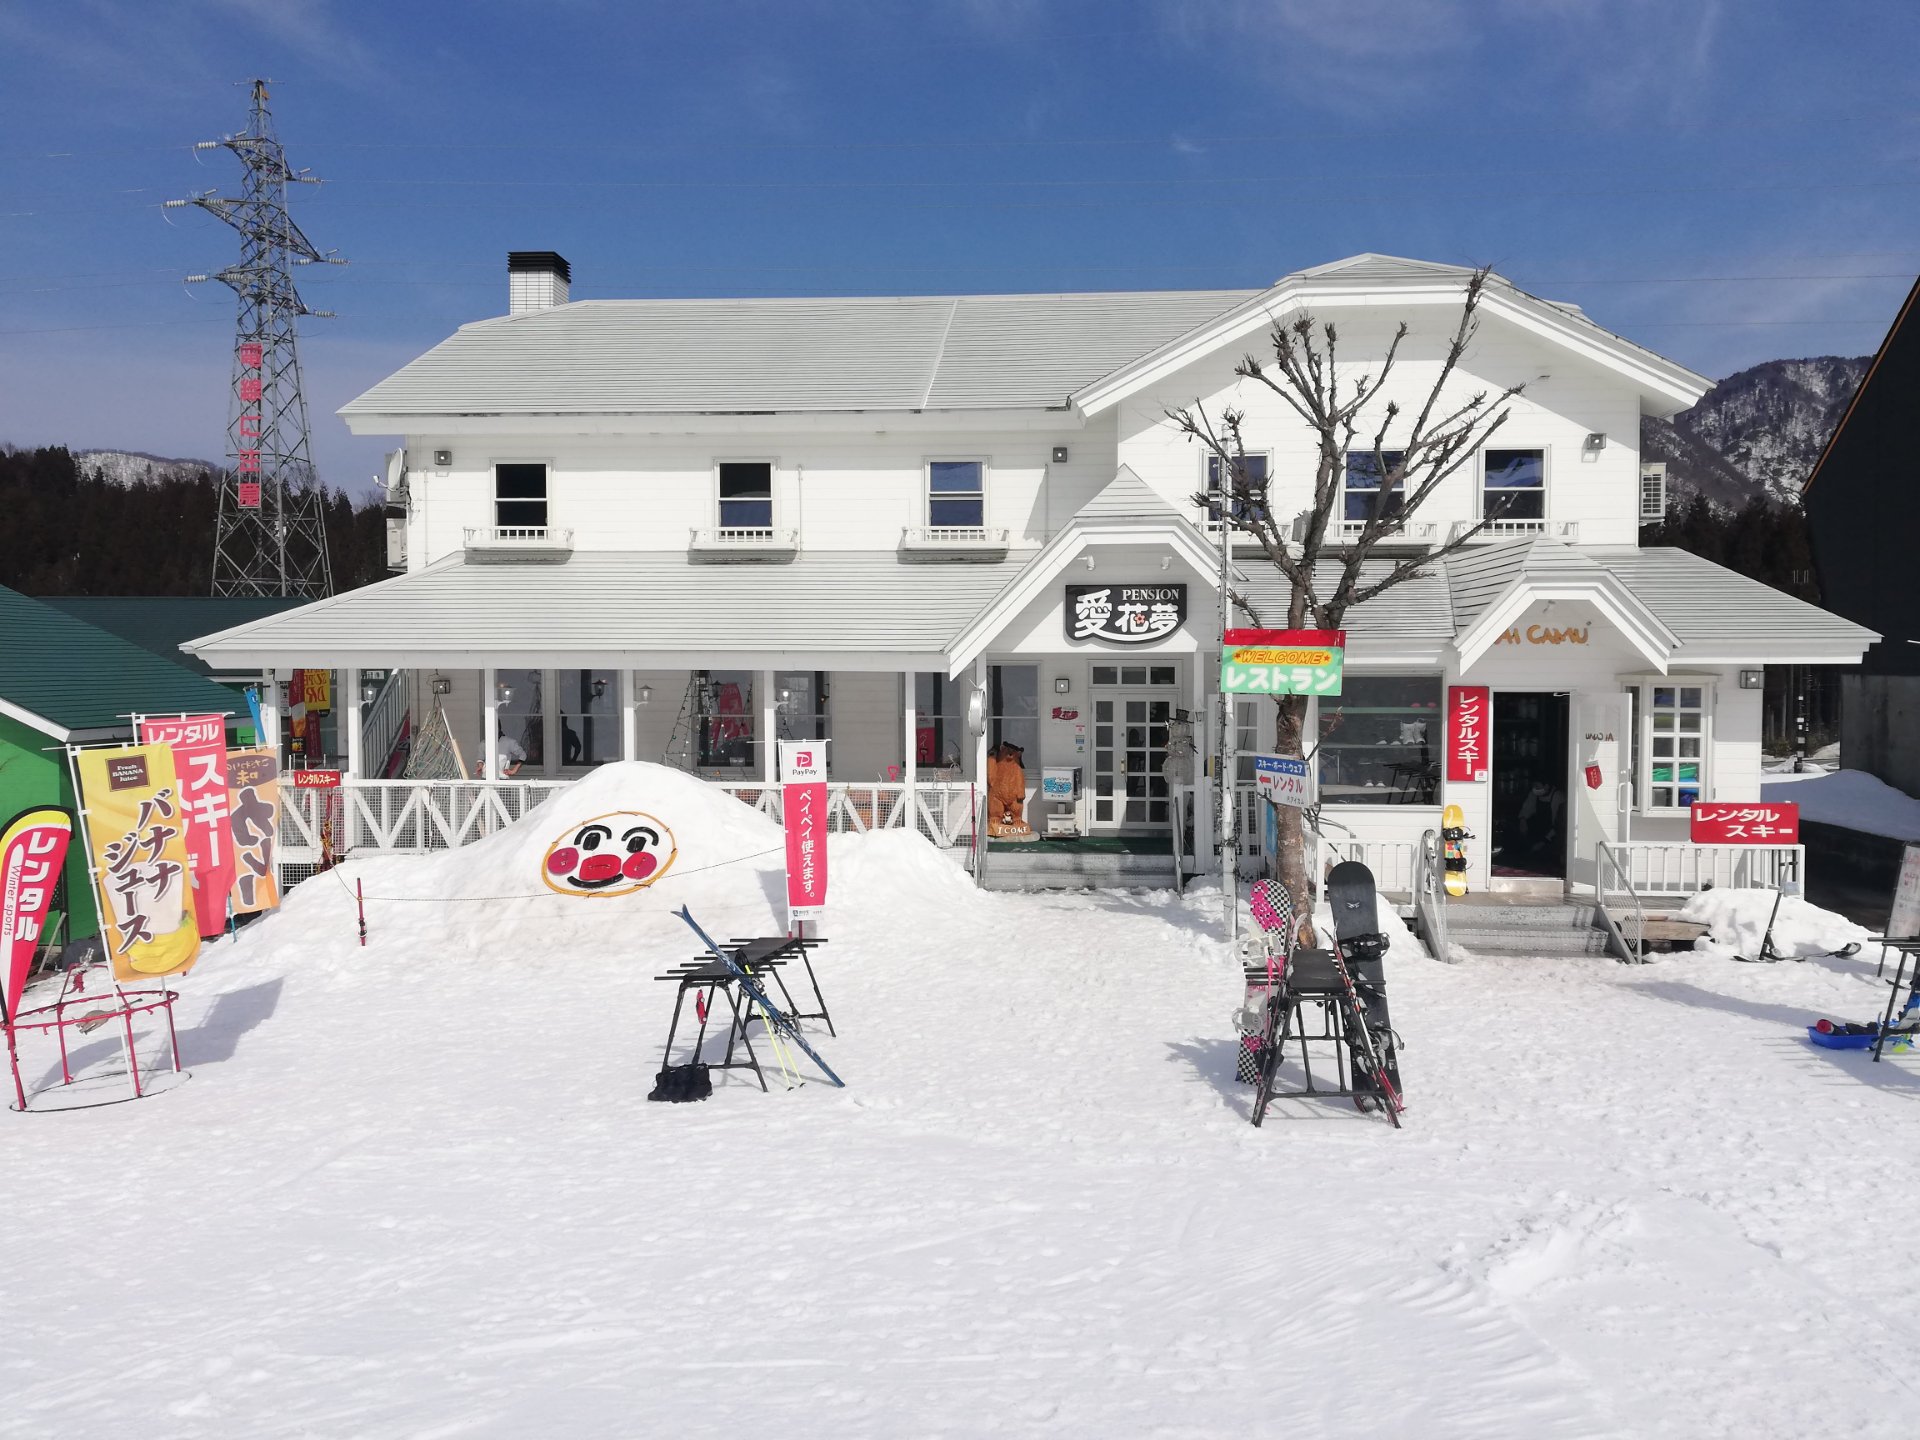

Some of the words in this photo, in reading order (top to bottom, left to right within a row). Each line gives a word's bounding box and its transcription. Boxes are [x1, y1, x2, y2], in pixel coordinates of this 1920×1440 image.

[1122, 588, 1180, 600] PENSION
[1074, 588, 1179, 642] 愛花夢
[1241, 650, 1325, 665] WELCOME
[1226, 666, 1338, 692] レストラン
[148, 724, 220, 744] レンタル
[1457, 691, 1480, 775] レンタルスキー
[112, 768, 144, 777] BANANA
[297, 773, 337, 785] レンタルスキー
[792, 767, 818, 776] PayPay
[1273, 775, 1303, 793] レンタル
[189, 753, 228, 867] スキー
[1696, 808, 1781, 822] レンタル
[137, 788, 181, 901] バナナ
[799, 789, 816, 898] ペイペイ使えます。
[1725, 825, 1793, 838] スキー
[8, 864, 22, 901] Winter
[14, 831, 58, 942] レンタル
[103, 831, 152, 954] ジュース
[4, 904, 14, 936] sports
